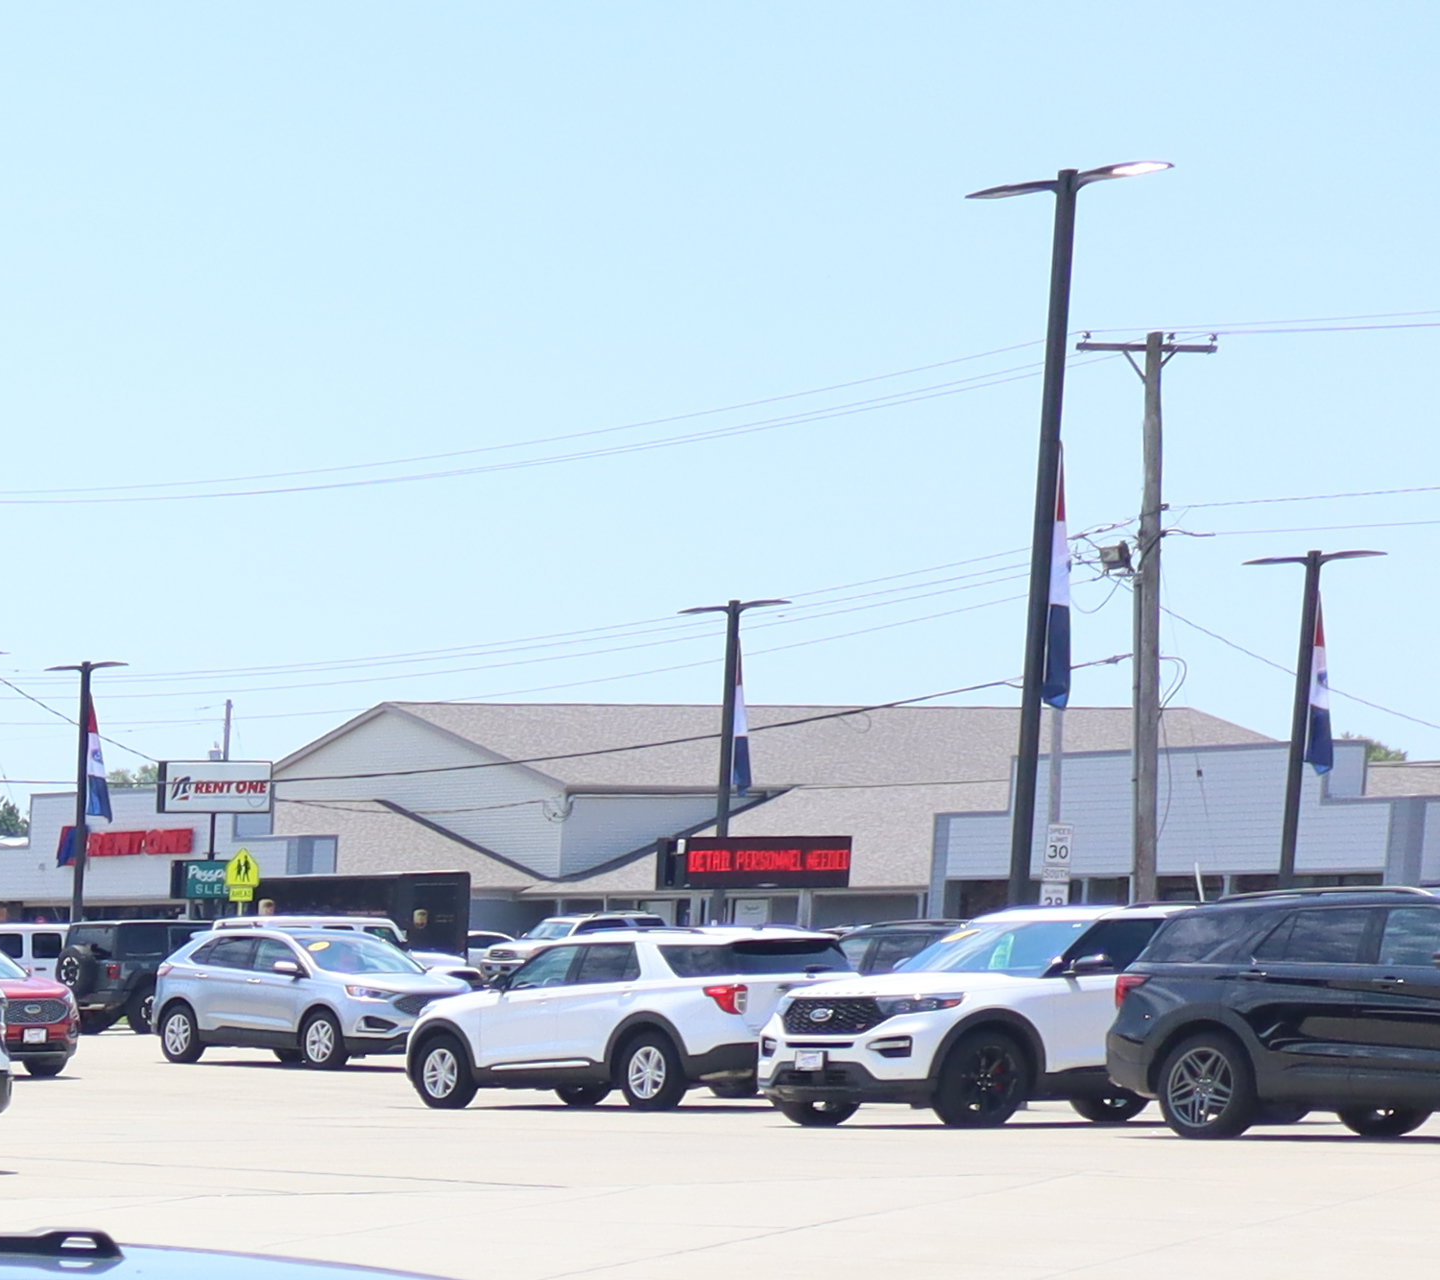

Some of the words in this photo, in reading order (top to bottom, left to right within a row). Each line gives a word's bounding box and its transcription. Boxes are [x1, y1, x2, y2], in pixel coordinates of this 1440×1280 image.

[195, 780, 234, 794] RENT
[236, 780, 268, 794] ONE
[88, 830, 147, 857] RENT
[146, 828, 194, 856] ONE
[1047, 844, 1069, 860] 30
[688, 850, 731, 872] DETAIL
[736, 849, 803, 871] PERSONNEL
